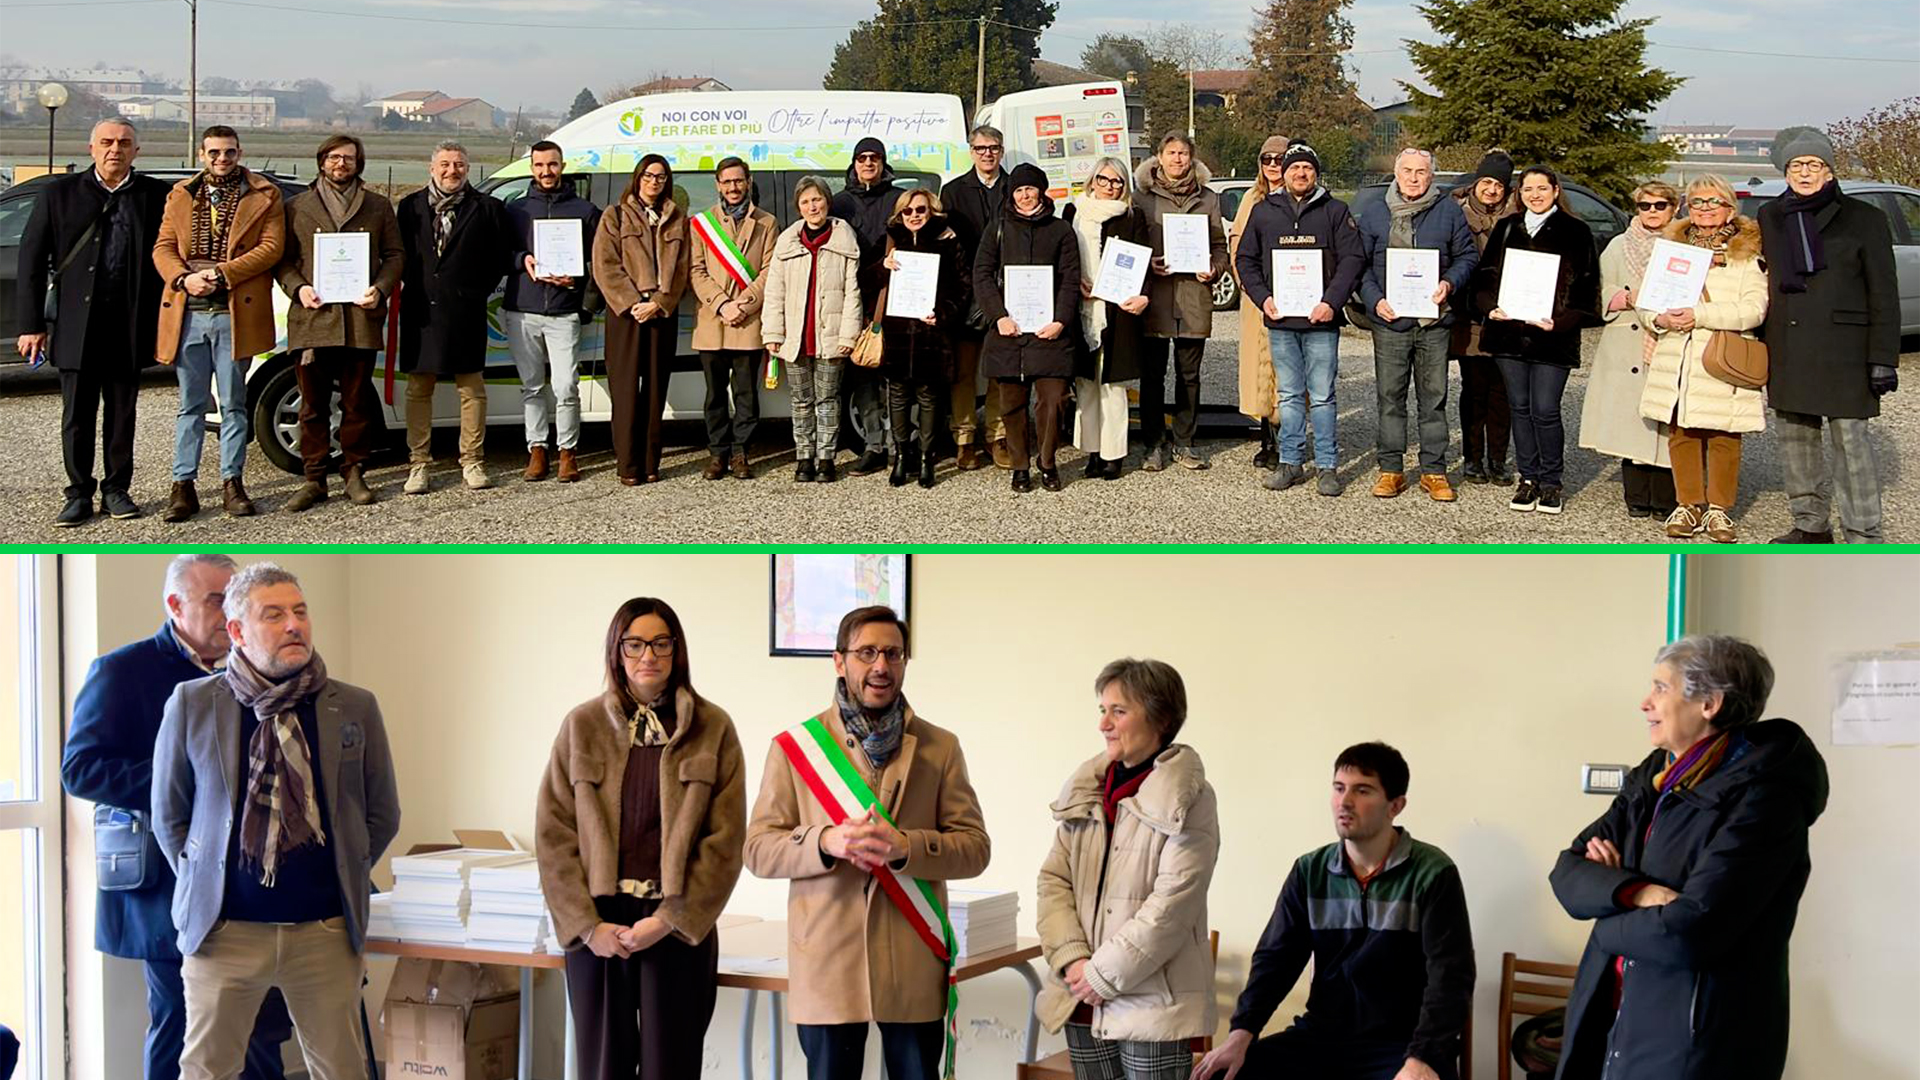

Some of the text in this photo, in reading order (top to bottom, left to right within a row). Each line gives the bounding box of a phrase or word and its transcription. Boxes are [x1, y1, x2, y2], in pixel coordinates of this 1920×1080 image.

[662, 110, 748, 122] NOI CON VOI
[767, 108, 948, 136] Oltre l'impatto positivo
[651, 121, 762, 137] PER FARE DI PIÙ
